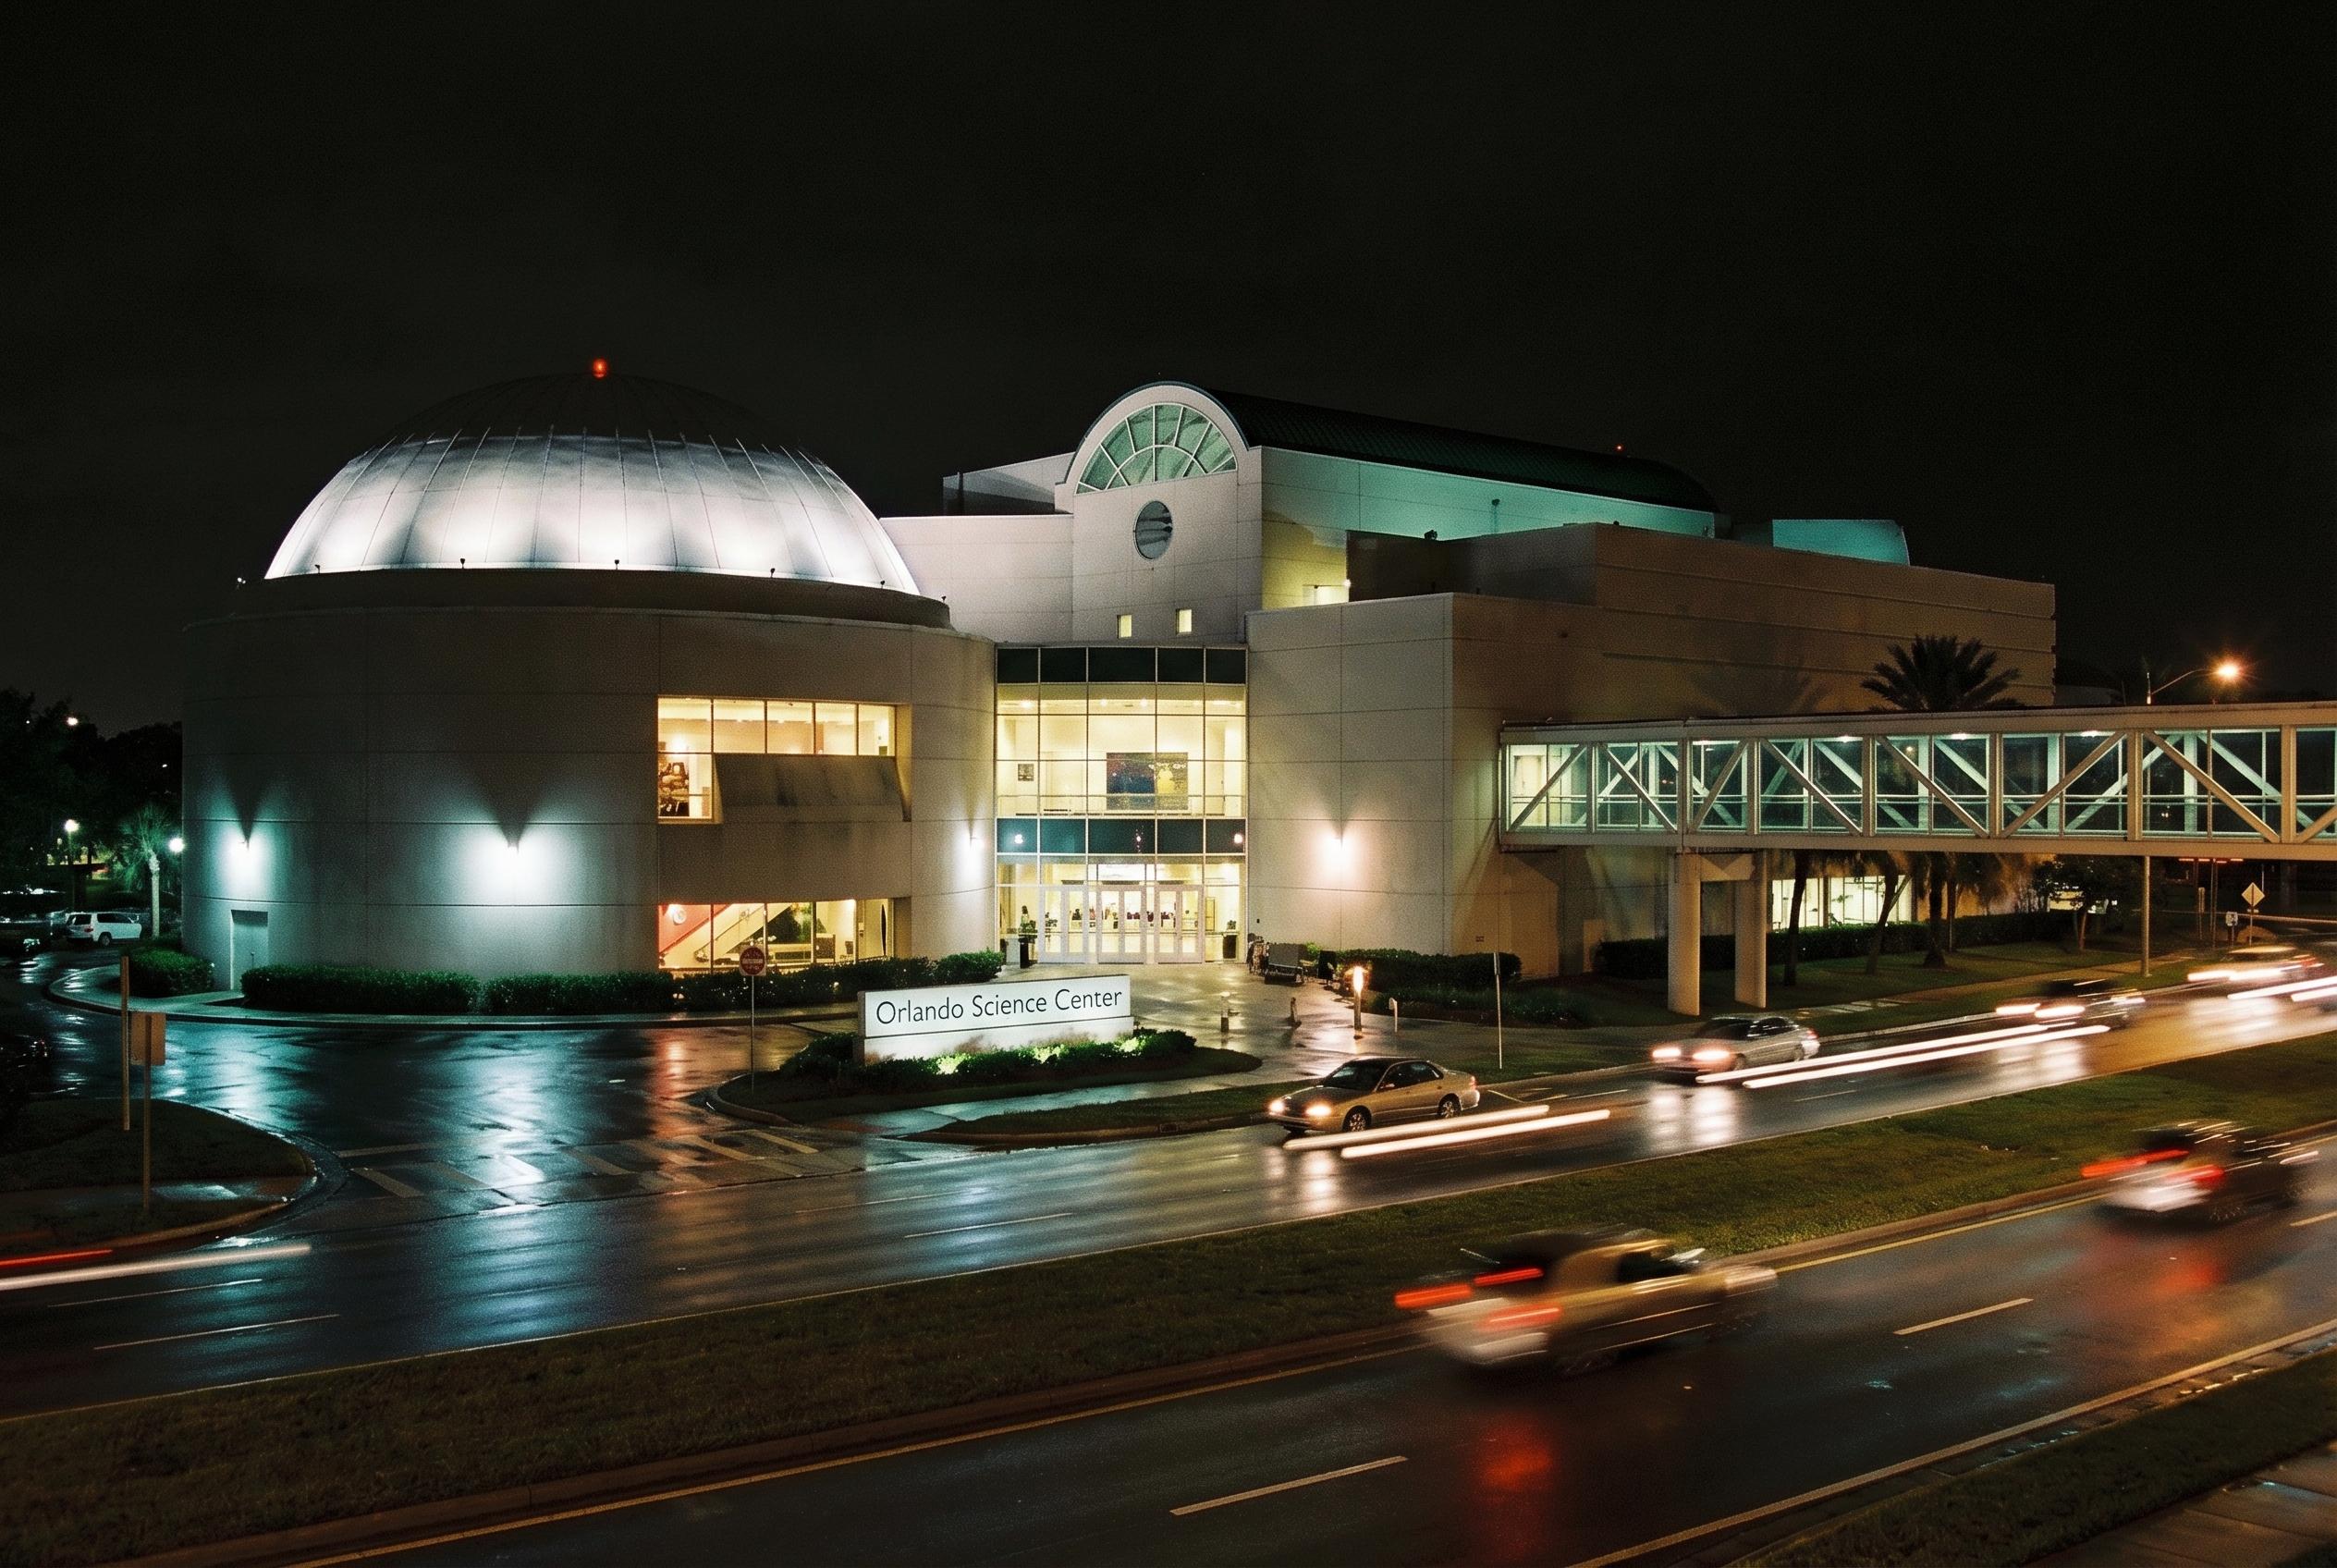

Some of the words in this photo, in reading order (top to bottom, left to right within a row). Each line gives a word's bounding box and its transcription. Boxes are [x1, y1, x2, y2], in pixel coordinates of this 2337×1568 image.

[876, 997, 963, 1024] Orlando
[973, 995, 1046, 1017] Science
[1055, 988, 1122, 1010] Center
